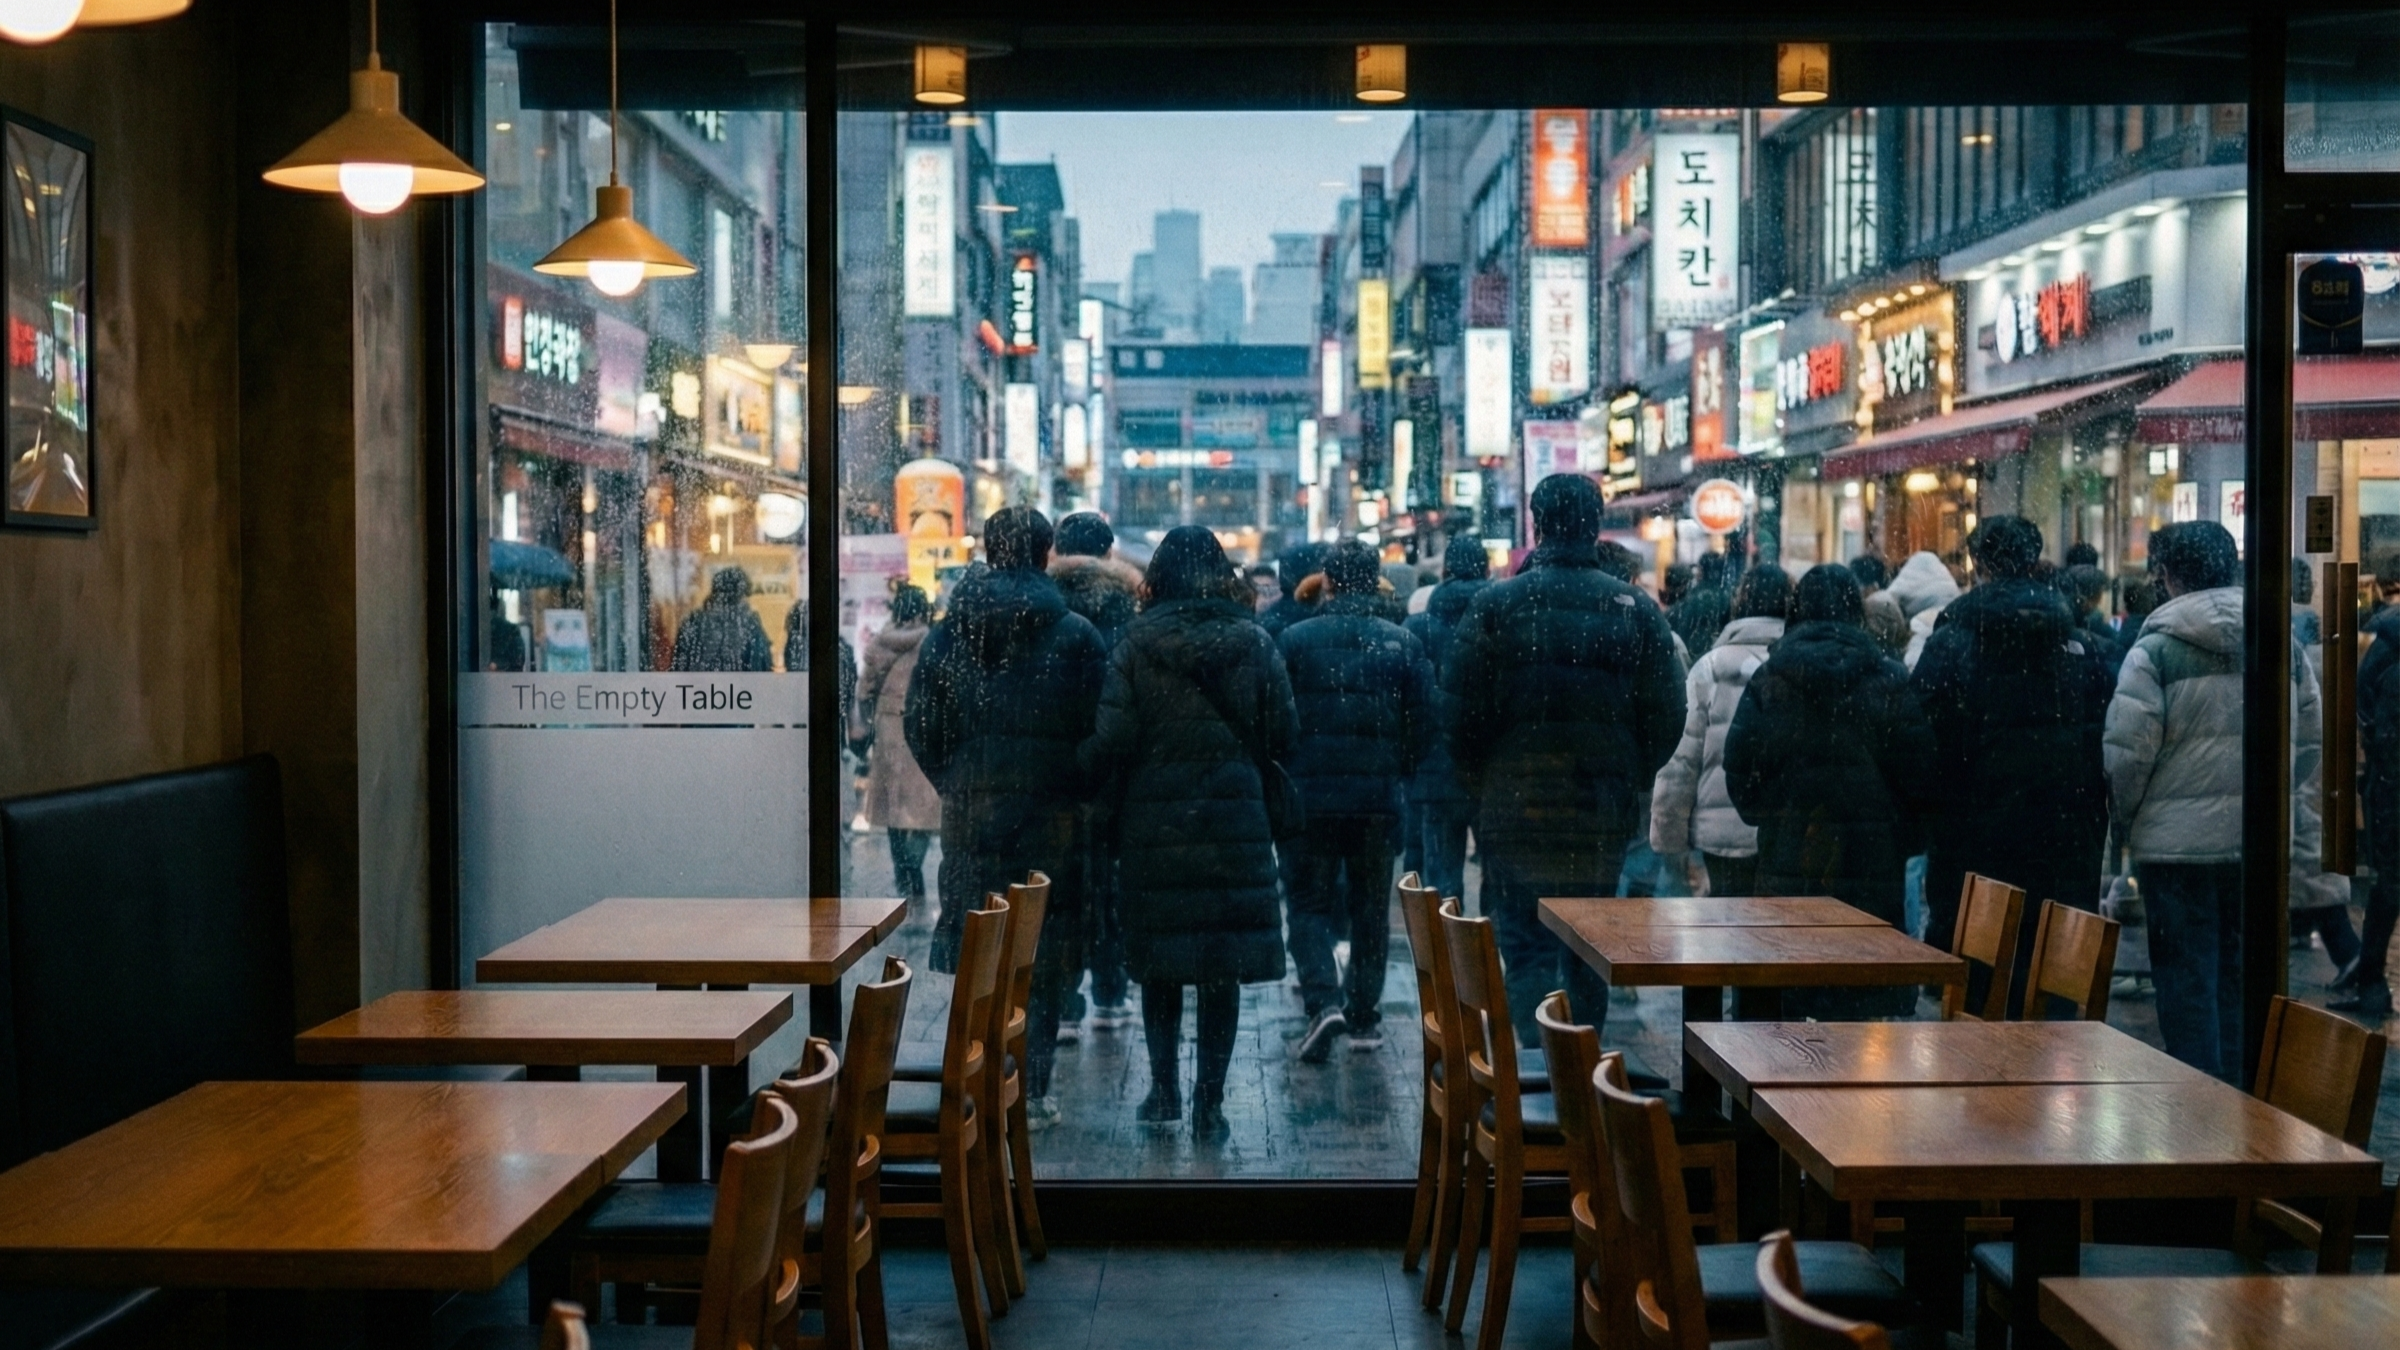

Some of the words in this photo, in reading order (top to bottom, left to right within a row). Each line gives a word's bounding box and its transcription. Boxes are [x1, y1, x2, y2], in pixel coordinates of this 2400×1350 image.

[1676, 151, 1716, 287] 도치칸
[511, 683, 566, 711] The
[576, 684, 667, 718] Empty
[675, 683, 753, 711] Table
